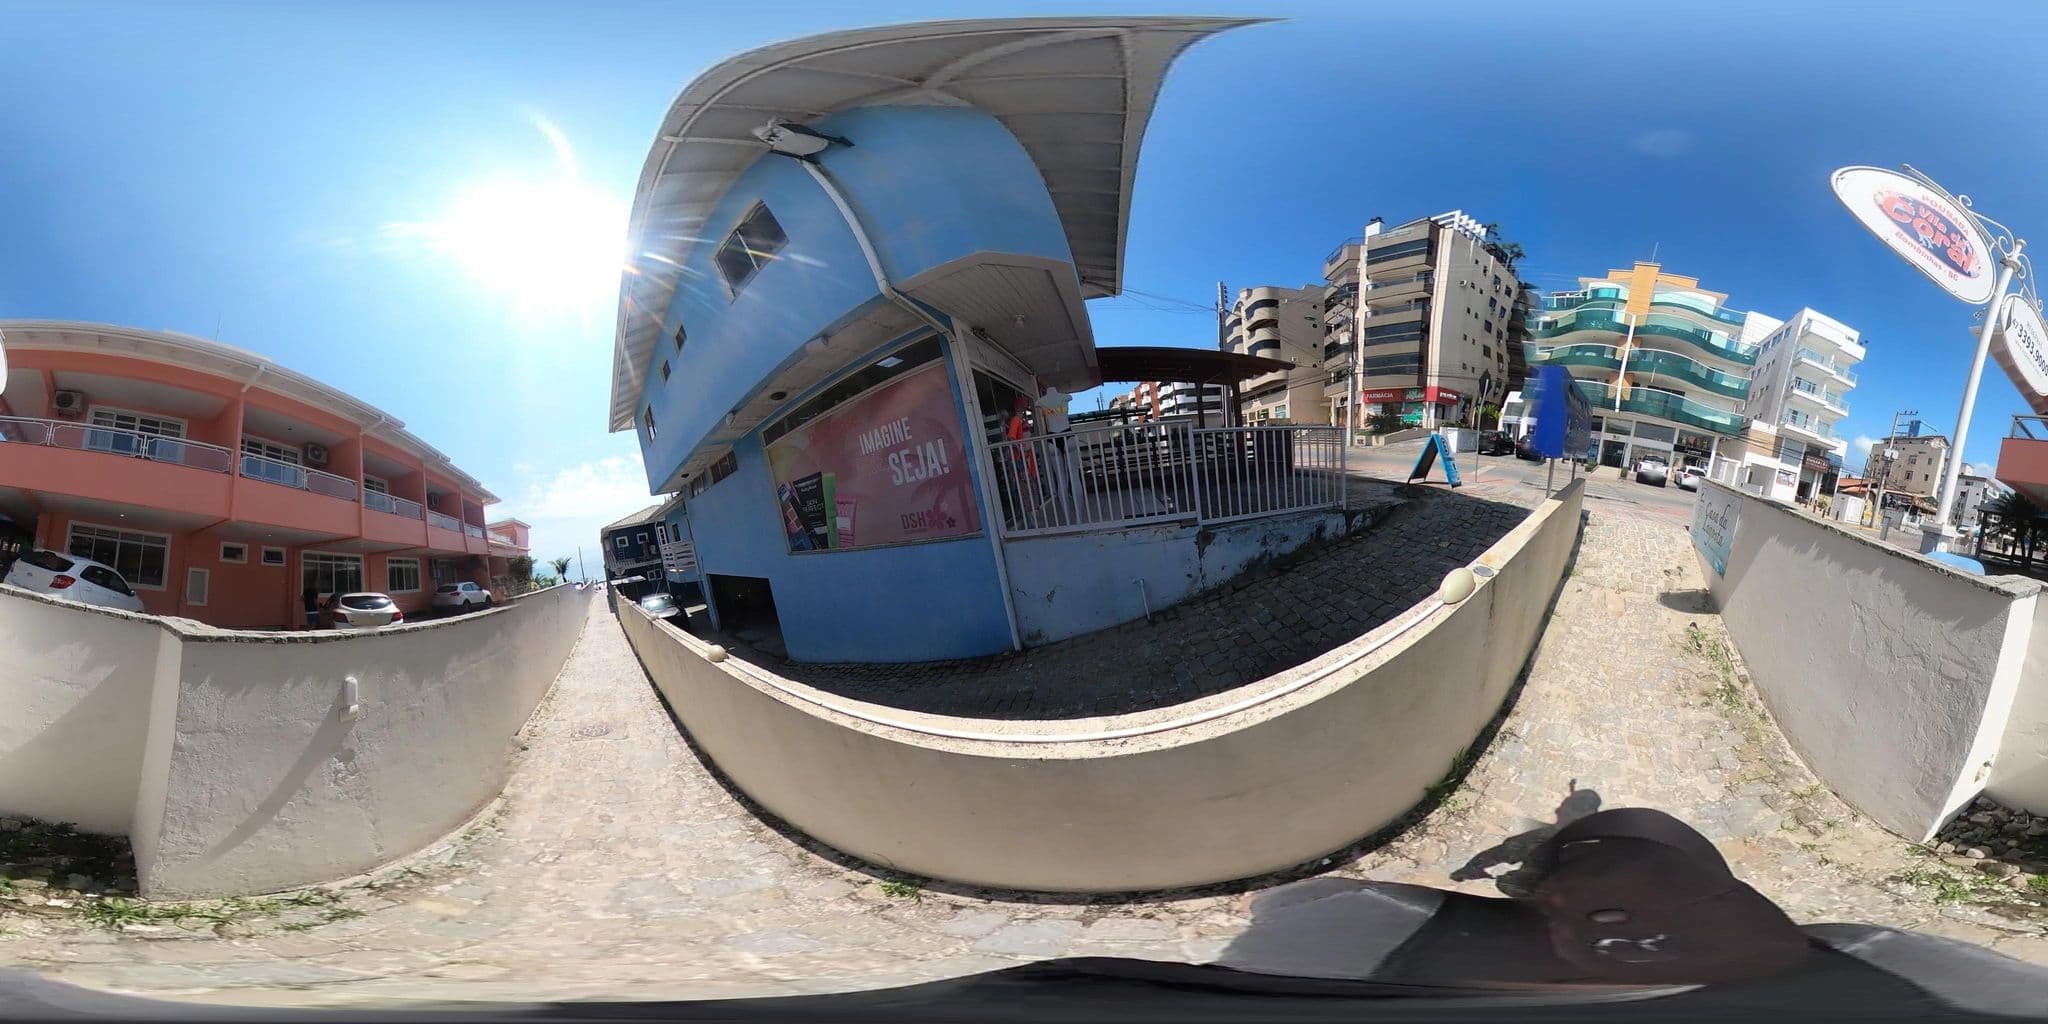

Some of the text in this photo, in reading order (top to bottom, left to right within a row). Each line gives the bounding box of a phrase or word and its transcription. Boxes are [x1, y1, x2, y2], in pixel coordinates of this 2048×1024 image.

[1881, 195, 1972, 273] Coral
[1919, 205, 1948, 234] Vila
[859, 417, 912, 455] IMAGINE
[888, 438, 950, 486] SEJA!
[901, 511, 927, 530] DSH
